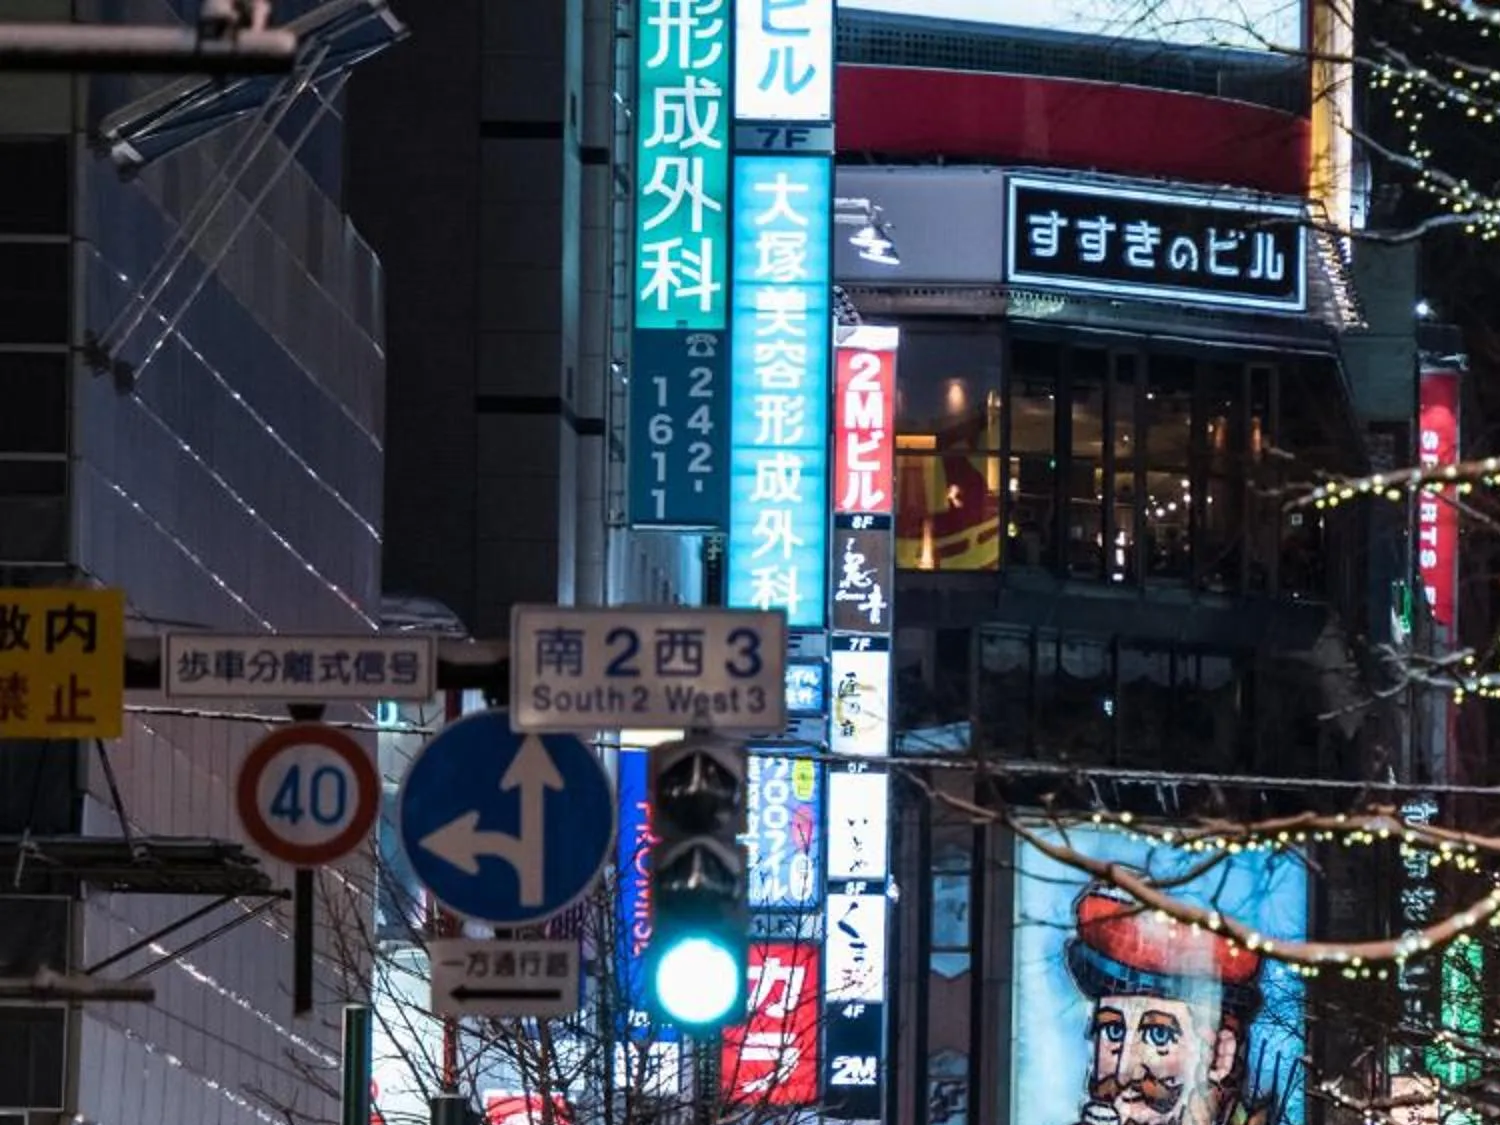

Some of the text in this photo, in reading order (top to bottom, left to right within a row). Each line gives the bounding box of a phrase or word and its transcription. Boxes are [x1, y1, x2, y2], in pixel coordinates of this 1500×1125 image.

[640, 0, 722, 312] 形成外科
[755, 127, 811, 150] 7F
[1028, 210, 1286, 281] すすきのビル
[749, 174, 808, 614] 大塚美容形成外科
[648, 376, 674, 520] 1611
[845, 353, 885, 509] 2Mビル
[851, 516, 873, 529] 8F
[178, 653, 418, 686] 歩車分離式信号
[536, 627, 764, 678] 南2西3
[269, 765, 348, 826] 40
[842, 1005, 865, 1018] 4F
[831, 1056, 877, 1085] 2M
